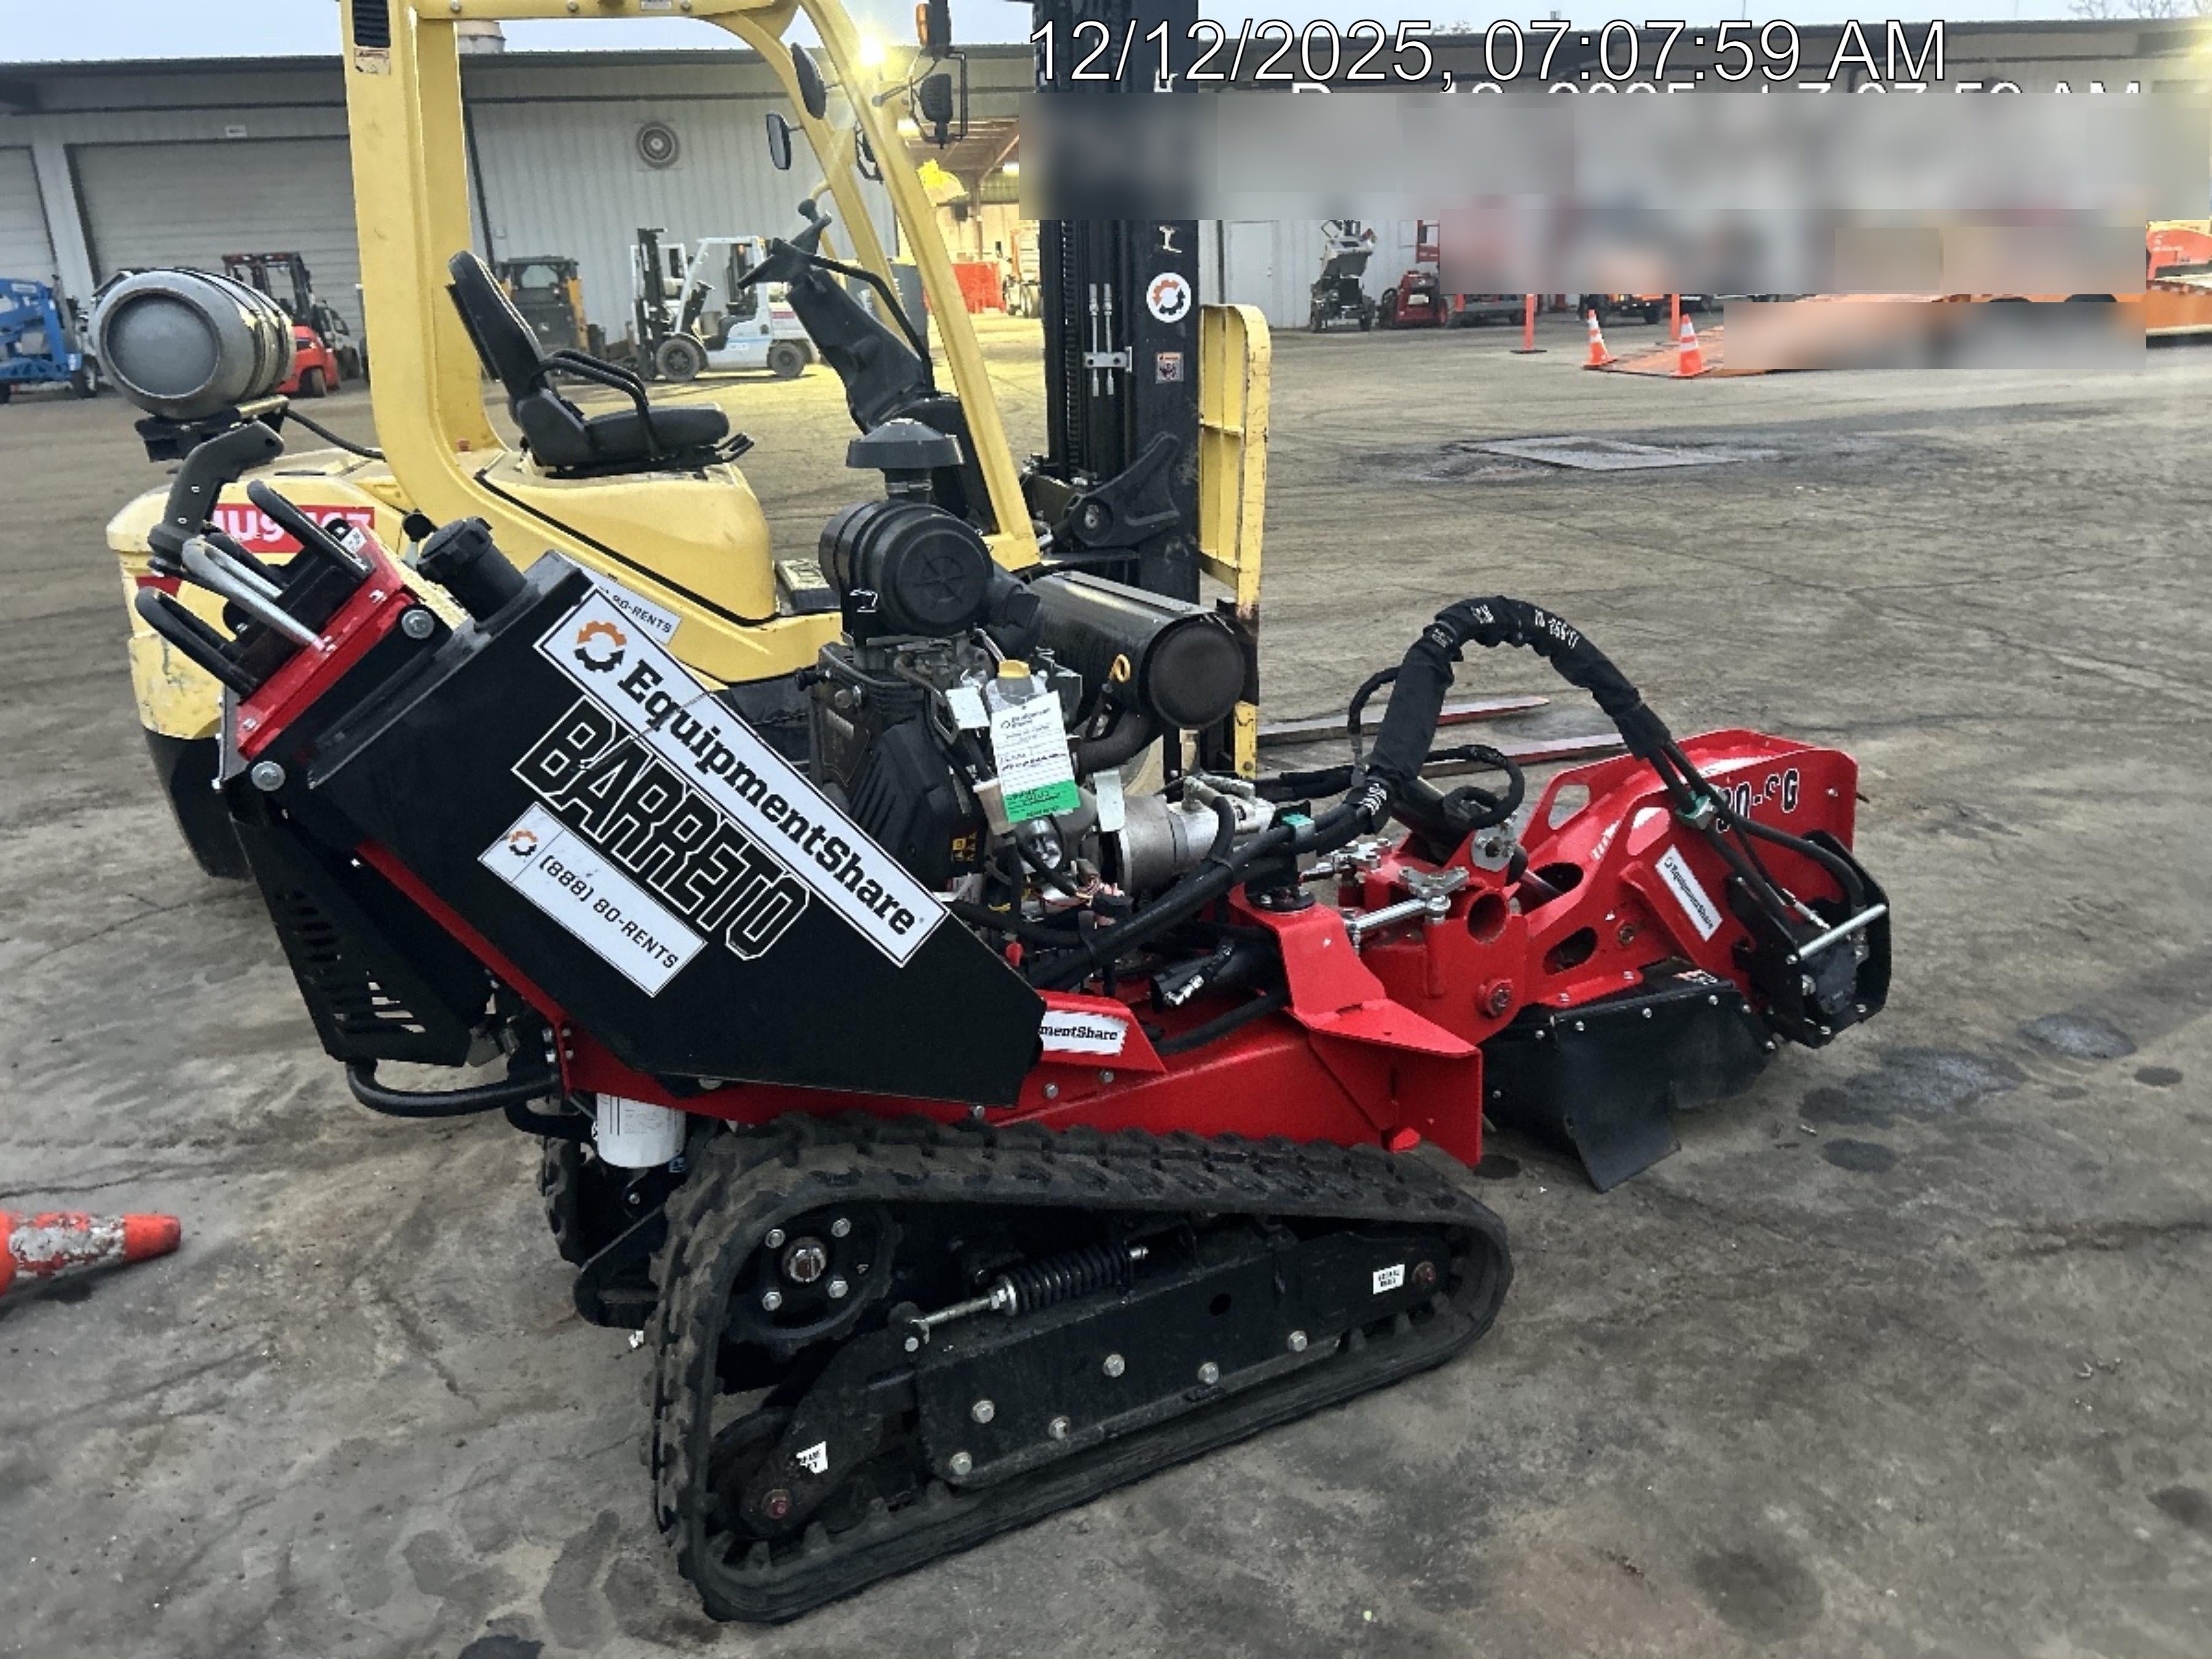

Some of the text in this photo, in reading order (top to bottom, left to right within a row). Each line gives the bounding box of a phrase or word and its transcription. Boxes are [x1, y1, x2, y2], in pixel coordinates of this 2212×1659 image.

[510, 693, 811, 962] BARRETO
[538, 855, 680, 969] (888) 80-RENTS
[616, 659, 917, 936] EquipmentShare
